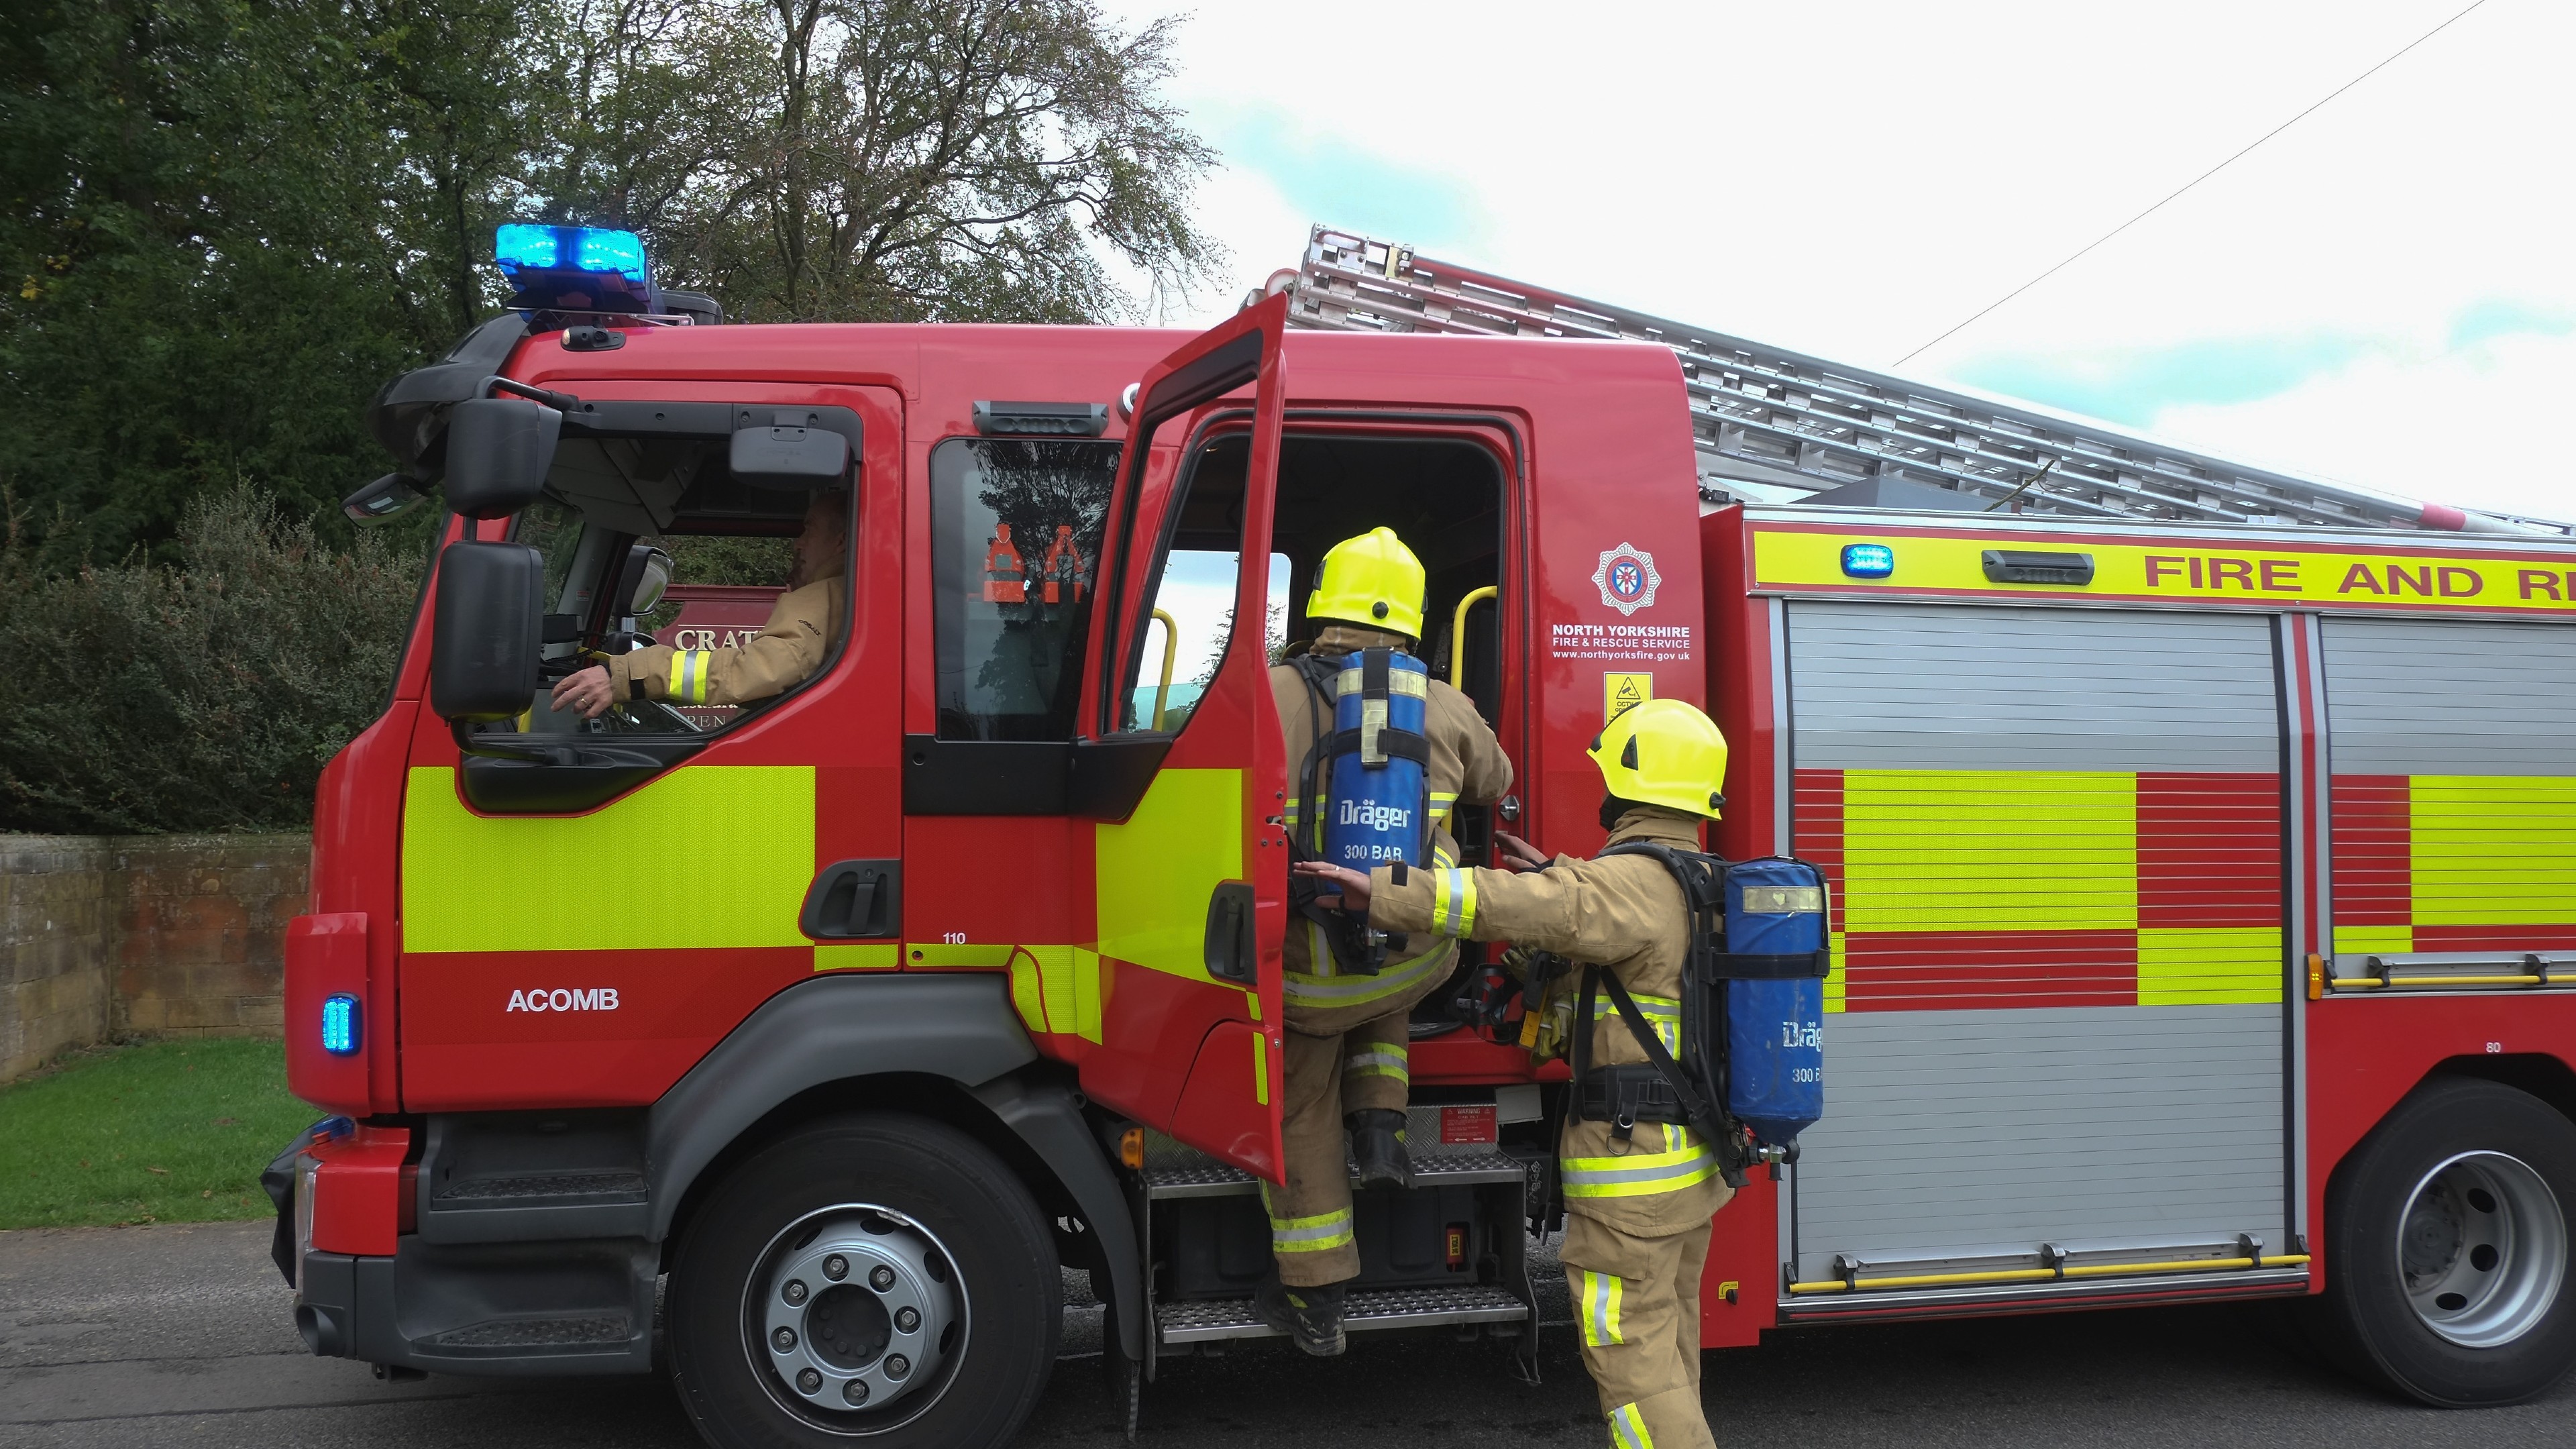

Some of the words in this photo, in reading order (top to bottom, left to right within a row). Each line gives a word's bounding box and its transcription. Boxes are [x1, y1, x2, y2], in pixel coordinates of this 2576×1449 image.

[2145, 555, 2303, 592] FIRE
[2337, 563, 2483, 597] AND
[2518, 569, 2576, 601] R
[1552, 625, 1603, 636] NORTH
[1607, 625, 1690, 638] YORKSHIRE
[675, 630, 763, 651] CRAT
[1552, 637, 1578, 647] FIRE
[1582, 638, 1590, 647] &
[1593, 639, 1639, 648] RESCUE
[1642, 639, 1690, 649] SERVICE
[1340, 799, 1411, 831] Dräger
[1344, 845, 1367, 859] 300
[1372, 845, 1402, 862] BAR
[943, 932, 966, 945] 110
[506, 988, 619, 1012] ACOMB
[2485, 1042, 2501, 1053] 80
[1792, 1068, 1813, 1083] 300
[1815, 1067, 1823, 1081] B
